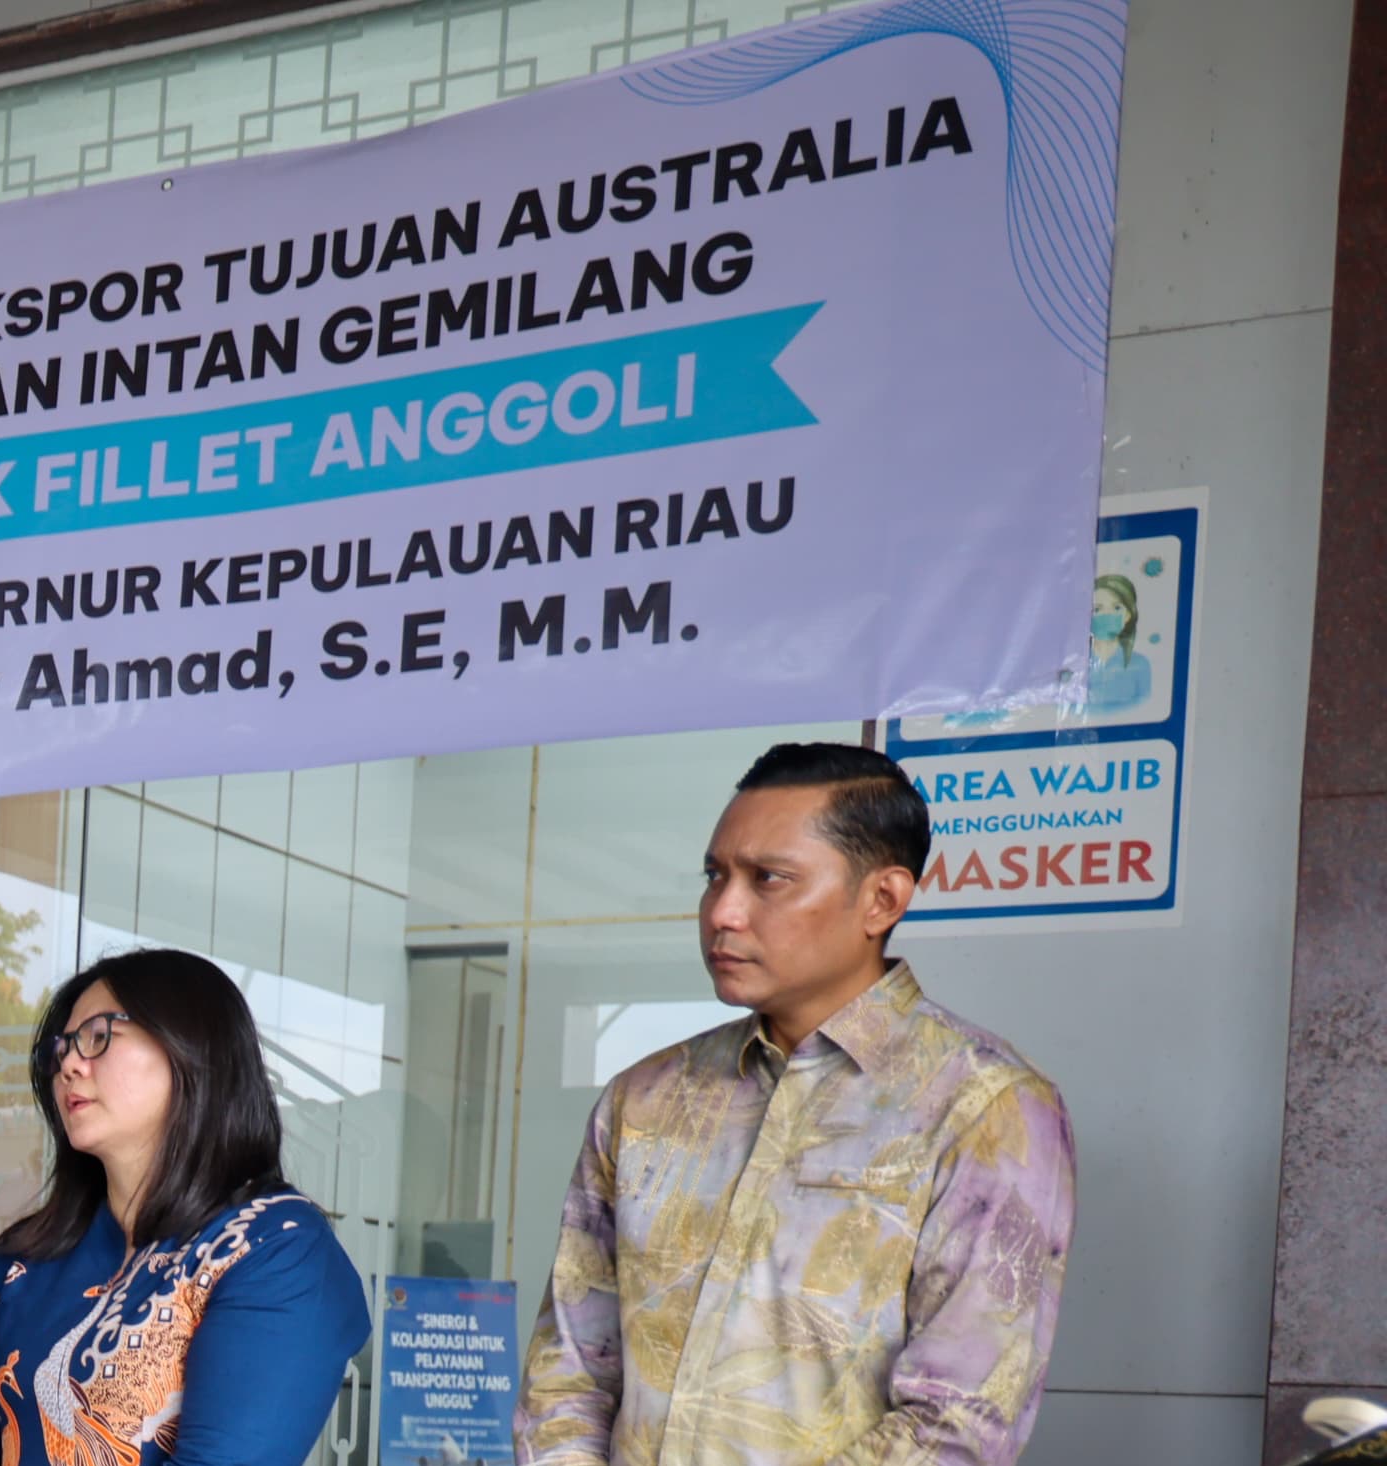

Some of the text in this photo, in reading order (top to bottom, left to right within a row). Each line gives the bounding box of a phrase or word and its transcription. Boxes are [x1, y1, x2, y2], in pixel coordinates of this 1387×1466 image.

[203, 200, 482, 305] TUJUAN
[497, 95, 974, 249] AUSTRALIA
[79, 316, 300, 406] INTAN
[318, 230, 754, 365] GEMILANG
[33, 422, 293, 512] FILLET
[312, 354, 697, 477] ANGGOLI
[180, 505, 595, 609] KEPULAUAN
[614, 476, 796, 554] RIAU
[16, 629, 295, 710] Ahmad,
[320, 609, 470, 681] S.E,
[498, 580, 699, 662] M.M.
[912, 758, 1161, 804] AREA WAJIB
[931, 808, 1123, 836] MENGGUNAKAN
[917, 840, 1156, 895] MASKER
[391, 1332, 506, 1352] KOLABORASI UNTUK
[415, 1353, 484, 1370] PELAYANAN
[390, 1371, 511, 1392] TRANSPORTASI YANG
